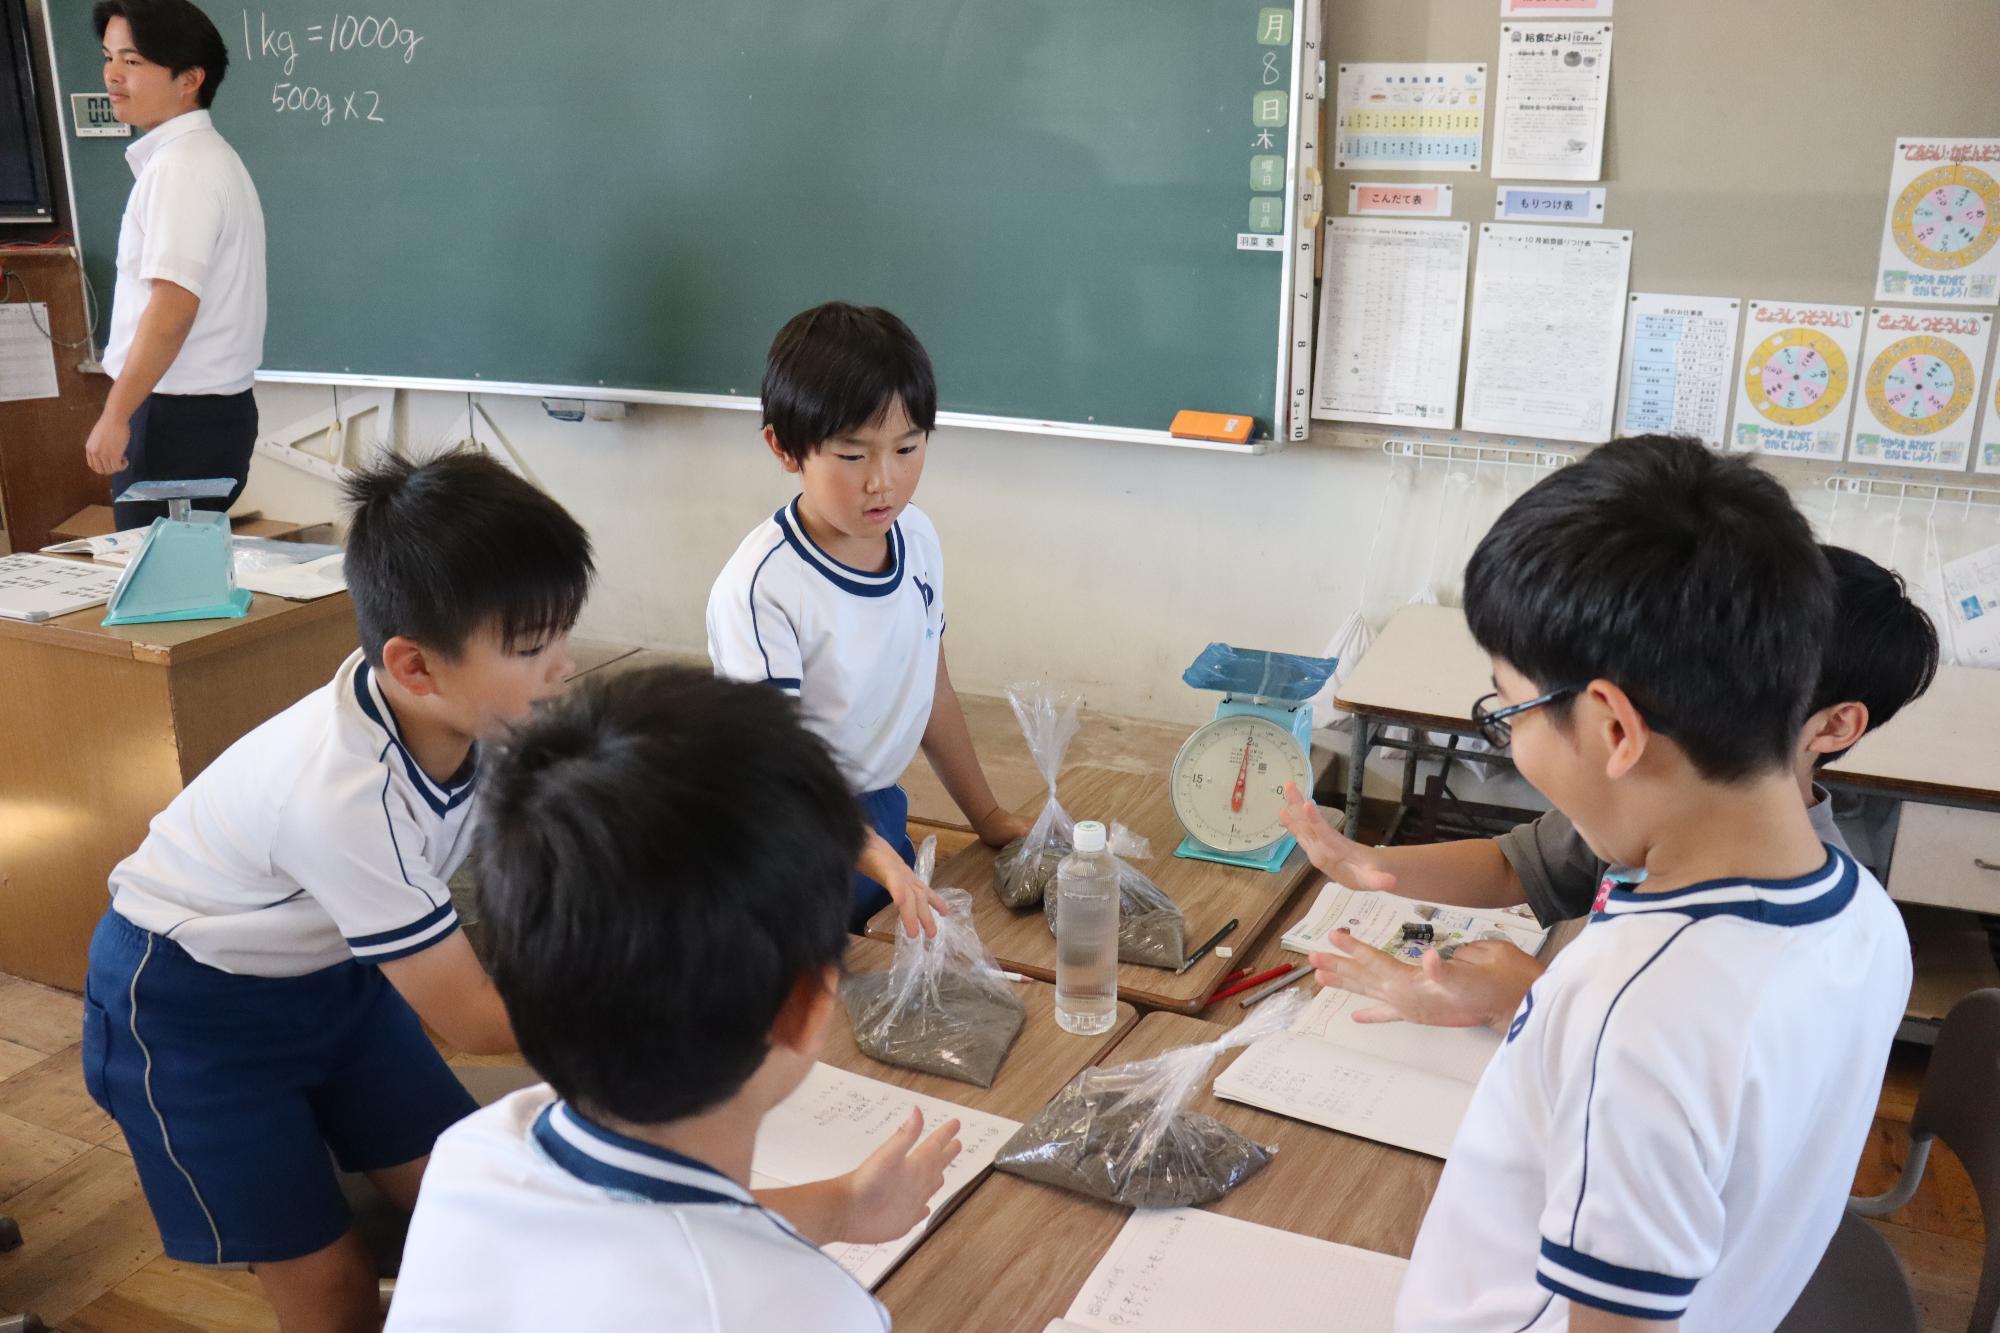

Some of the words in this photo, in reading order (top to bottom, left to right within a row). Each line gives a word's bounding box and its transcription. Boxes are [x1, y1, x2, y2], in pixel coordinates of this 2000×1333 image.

[1263, 14, 1284, 42] 月
[1525, 32, 1571, 43] 給食だより
[1262, 51, 1280, 85] 8
[1262, 99, 1279, 120] 日
[1256, 128, 1275, 150] 木
[1371, 193, 1423, 205] こんだて表
[1520, 198, 1574, 211] もりつけ表
[1294, 425, 1304, 438] 10
